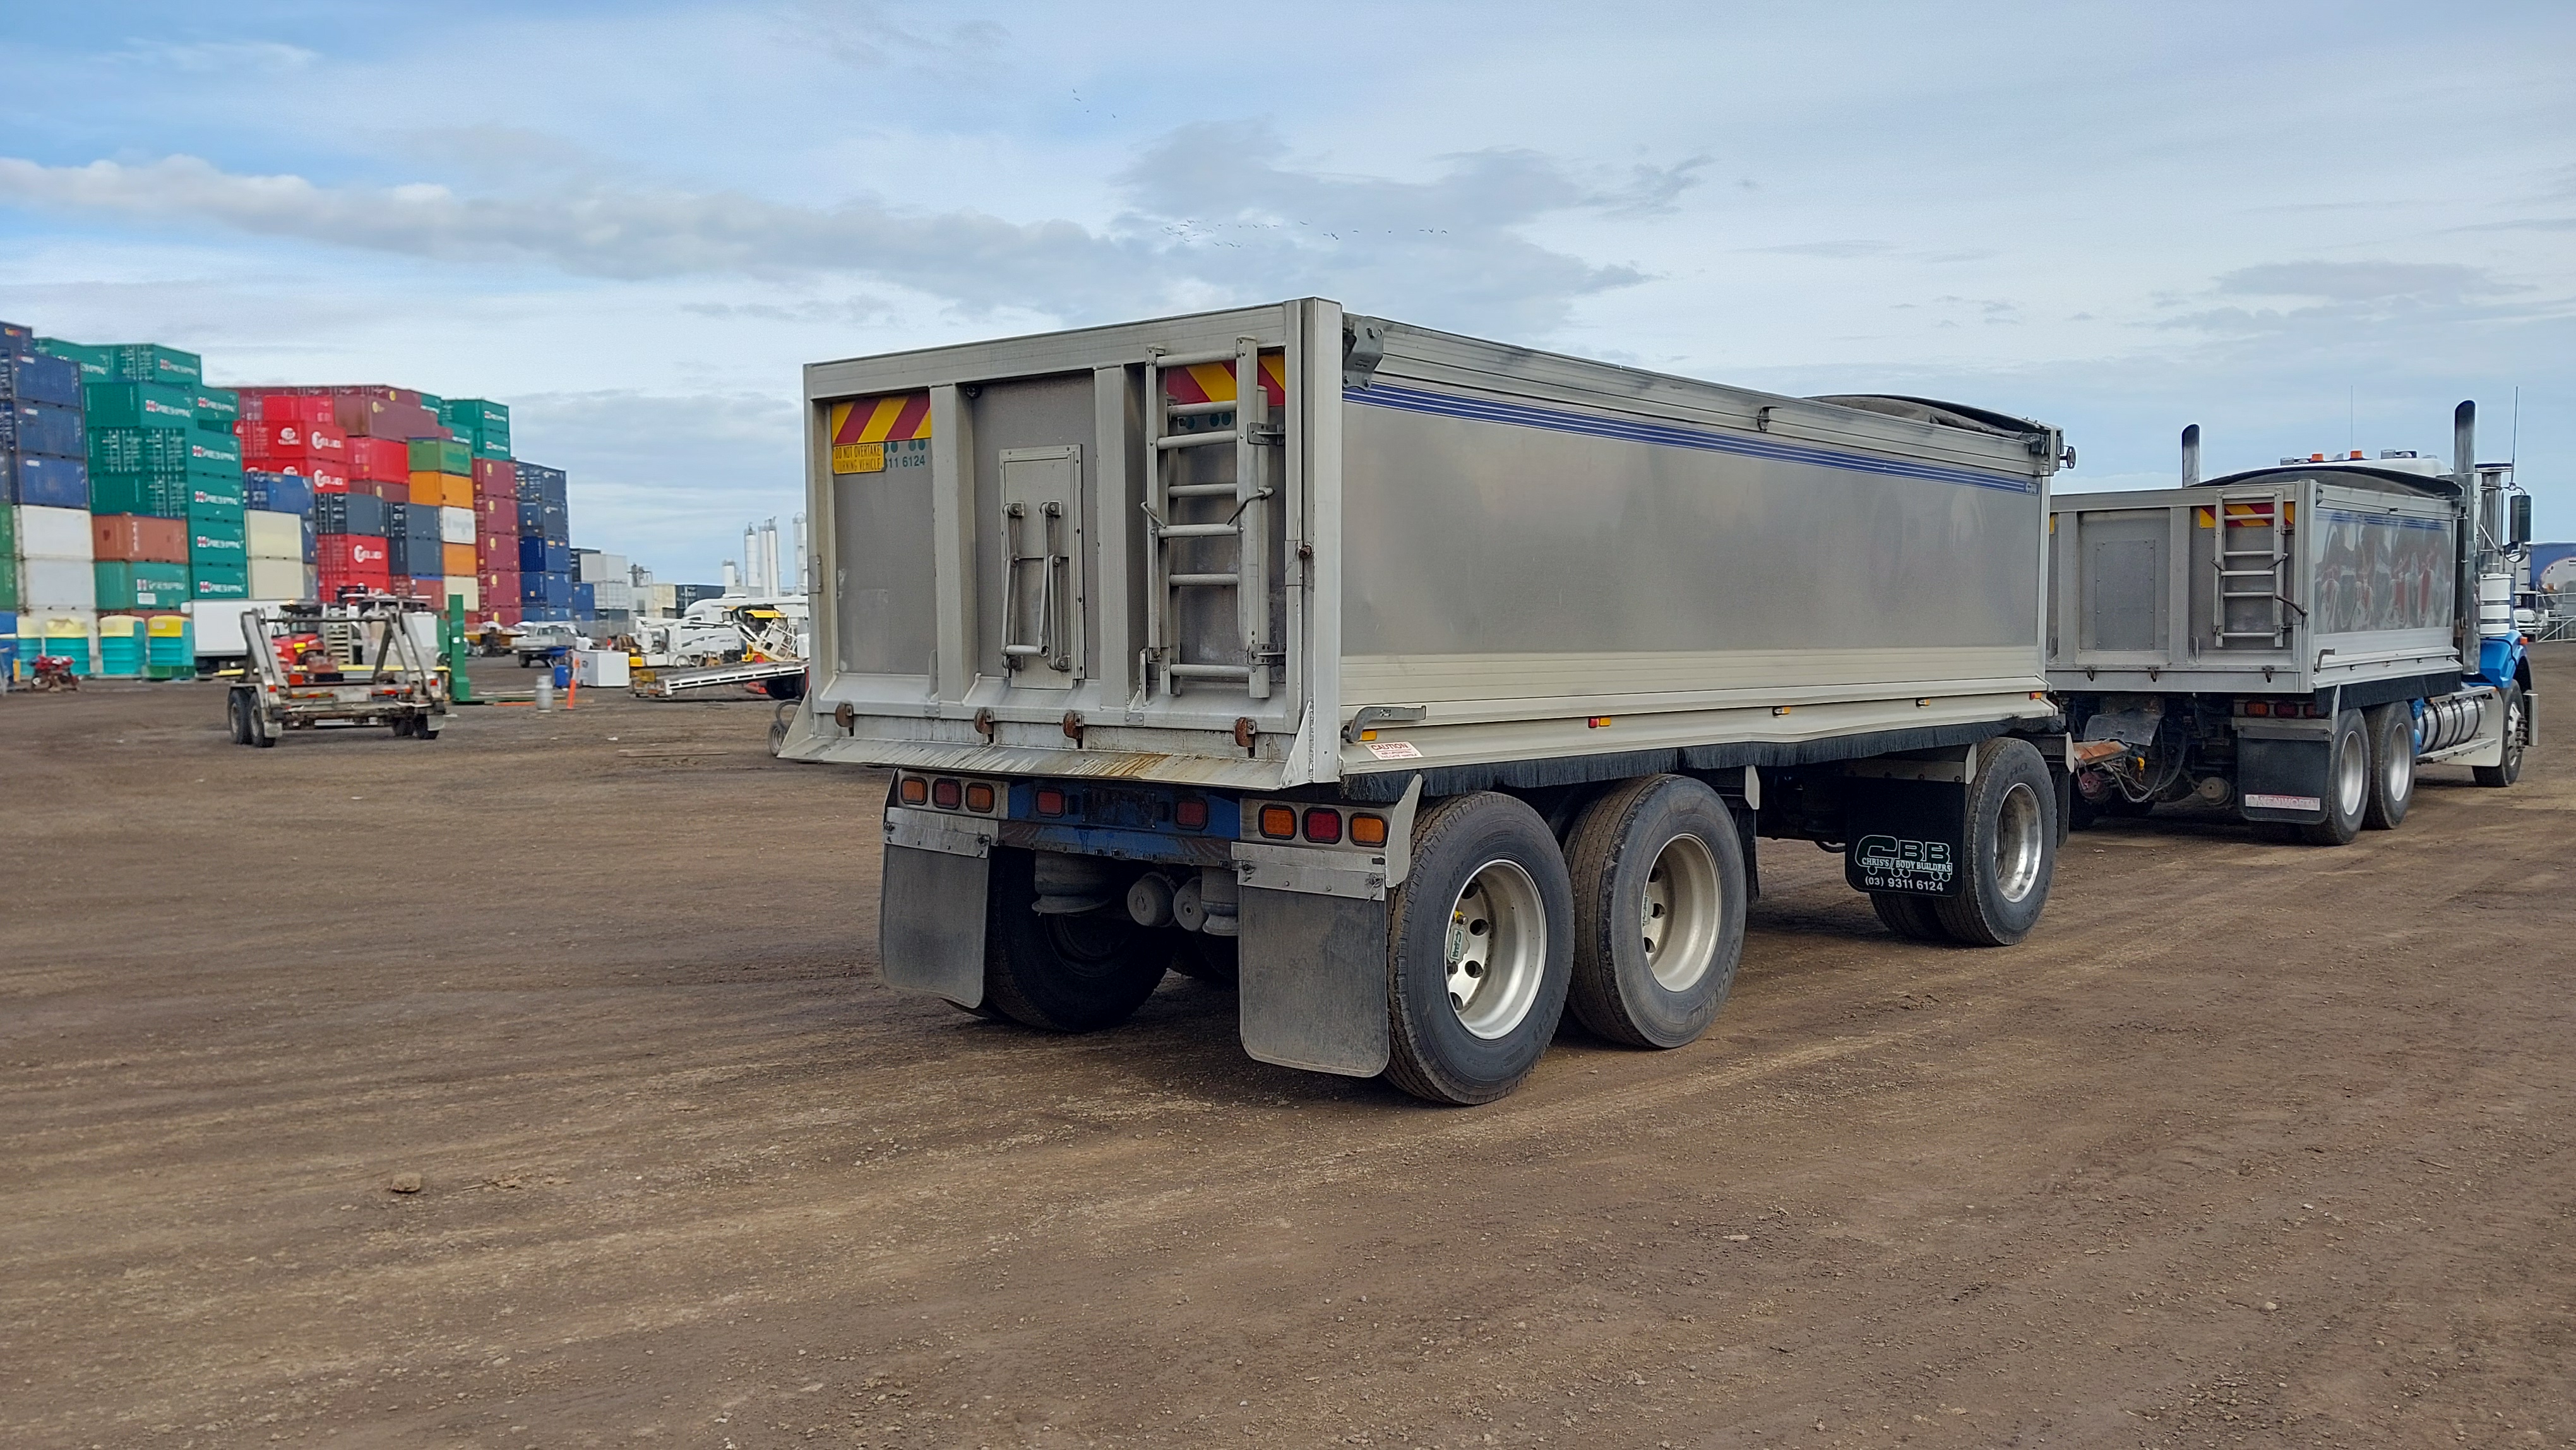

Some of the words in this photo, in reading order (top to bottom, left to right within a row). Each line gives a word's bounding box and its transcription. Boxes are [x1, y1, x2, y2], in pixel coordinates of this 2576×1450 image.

[835, 447, 842, 459] DO
[844, 446, 852, 458] NOT
[854, 445, 881, 458] OVERTAKE
[859, 458, 881, 472] VEHICLE
[902, 455, 925, 468] 6124
[1862, 857, 1889, 867] CHRIS'S
[1895, 860, 1916, 869] BODY
[1917, 862, 1951, 872] BUILDERS
[1864, 875, 1884, 887] (03)
[1887, 878, 1913, 889] 9311
[1916, 880, 1943, 892] 6124
